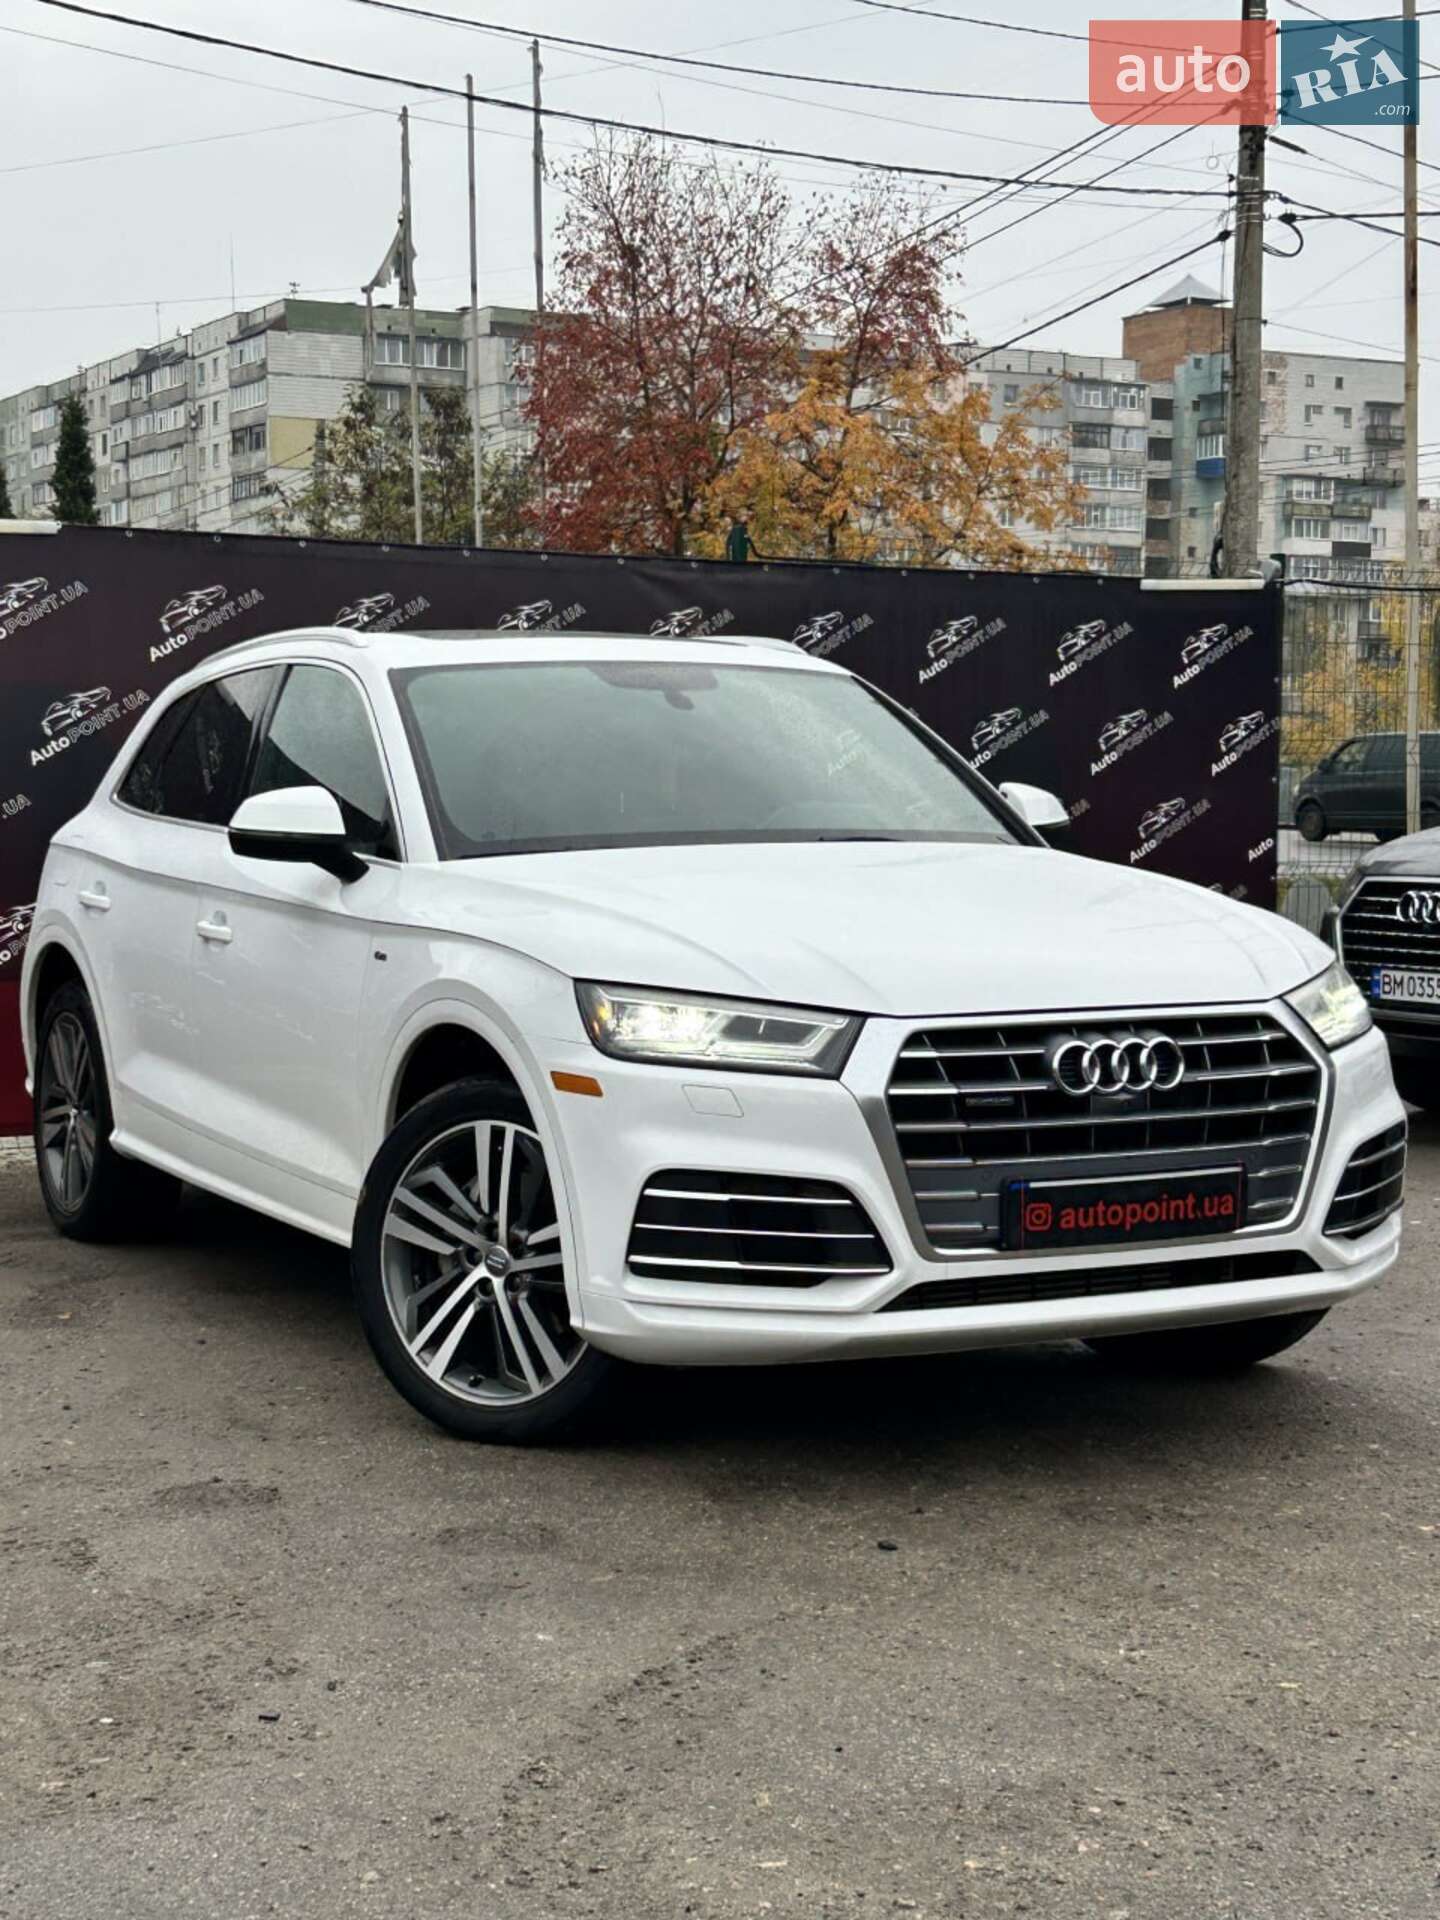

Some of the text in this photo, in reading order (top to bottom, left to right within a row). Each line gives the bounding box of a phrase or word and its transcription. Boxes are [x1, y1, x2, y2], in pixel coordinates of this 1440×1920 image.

[149, 588, 264, 662] AutoPOINT.UA
[918, 617, 1007, 684] AutoPOINT.UA
[1049, 621, 1134, 687] AutoPOINT.UA
[1172, 625, 1254, 689] AutoPOINT.UA
[30, 688, 150, 766] AutoPOINT.UA
[969, 709, 1049, 769] utoPOINT.UA
[1090, 710, 1174, 777] AutoPOINT.UA
[1130, 798, 1212, 864] AutoPOINT.UA
[1247, 837, 1275, 864] Auto
[1059, 1193, 1234, 1231] autopoint.ua
